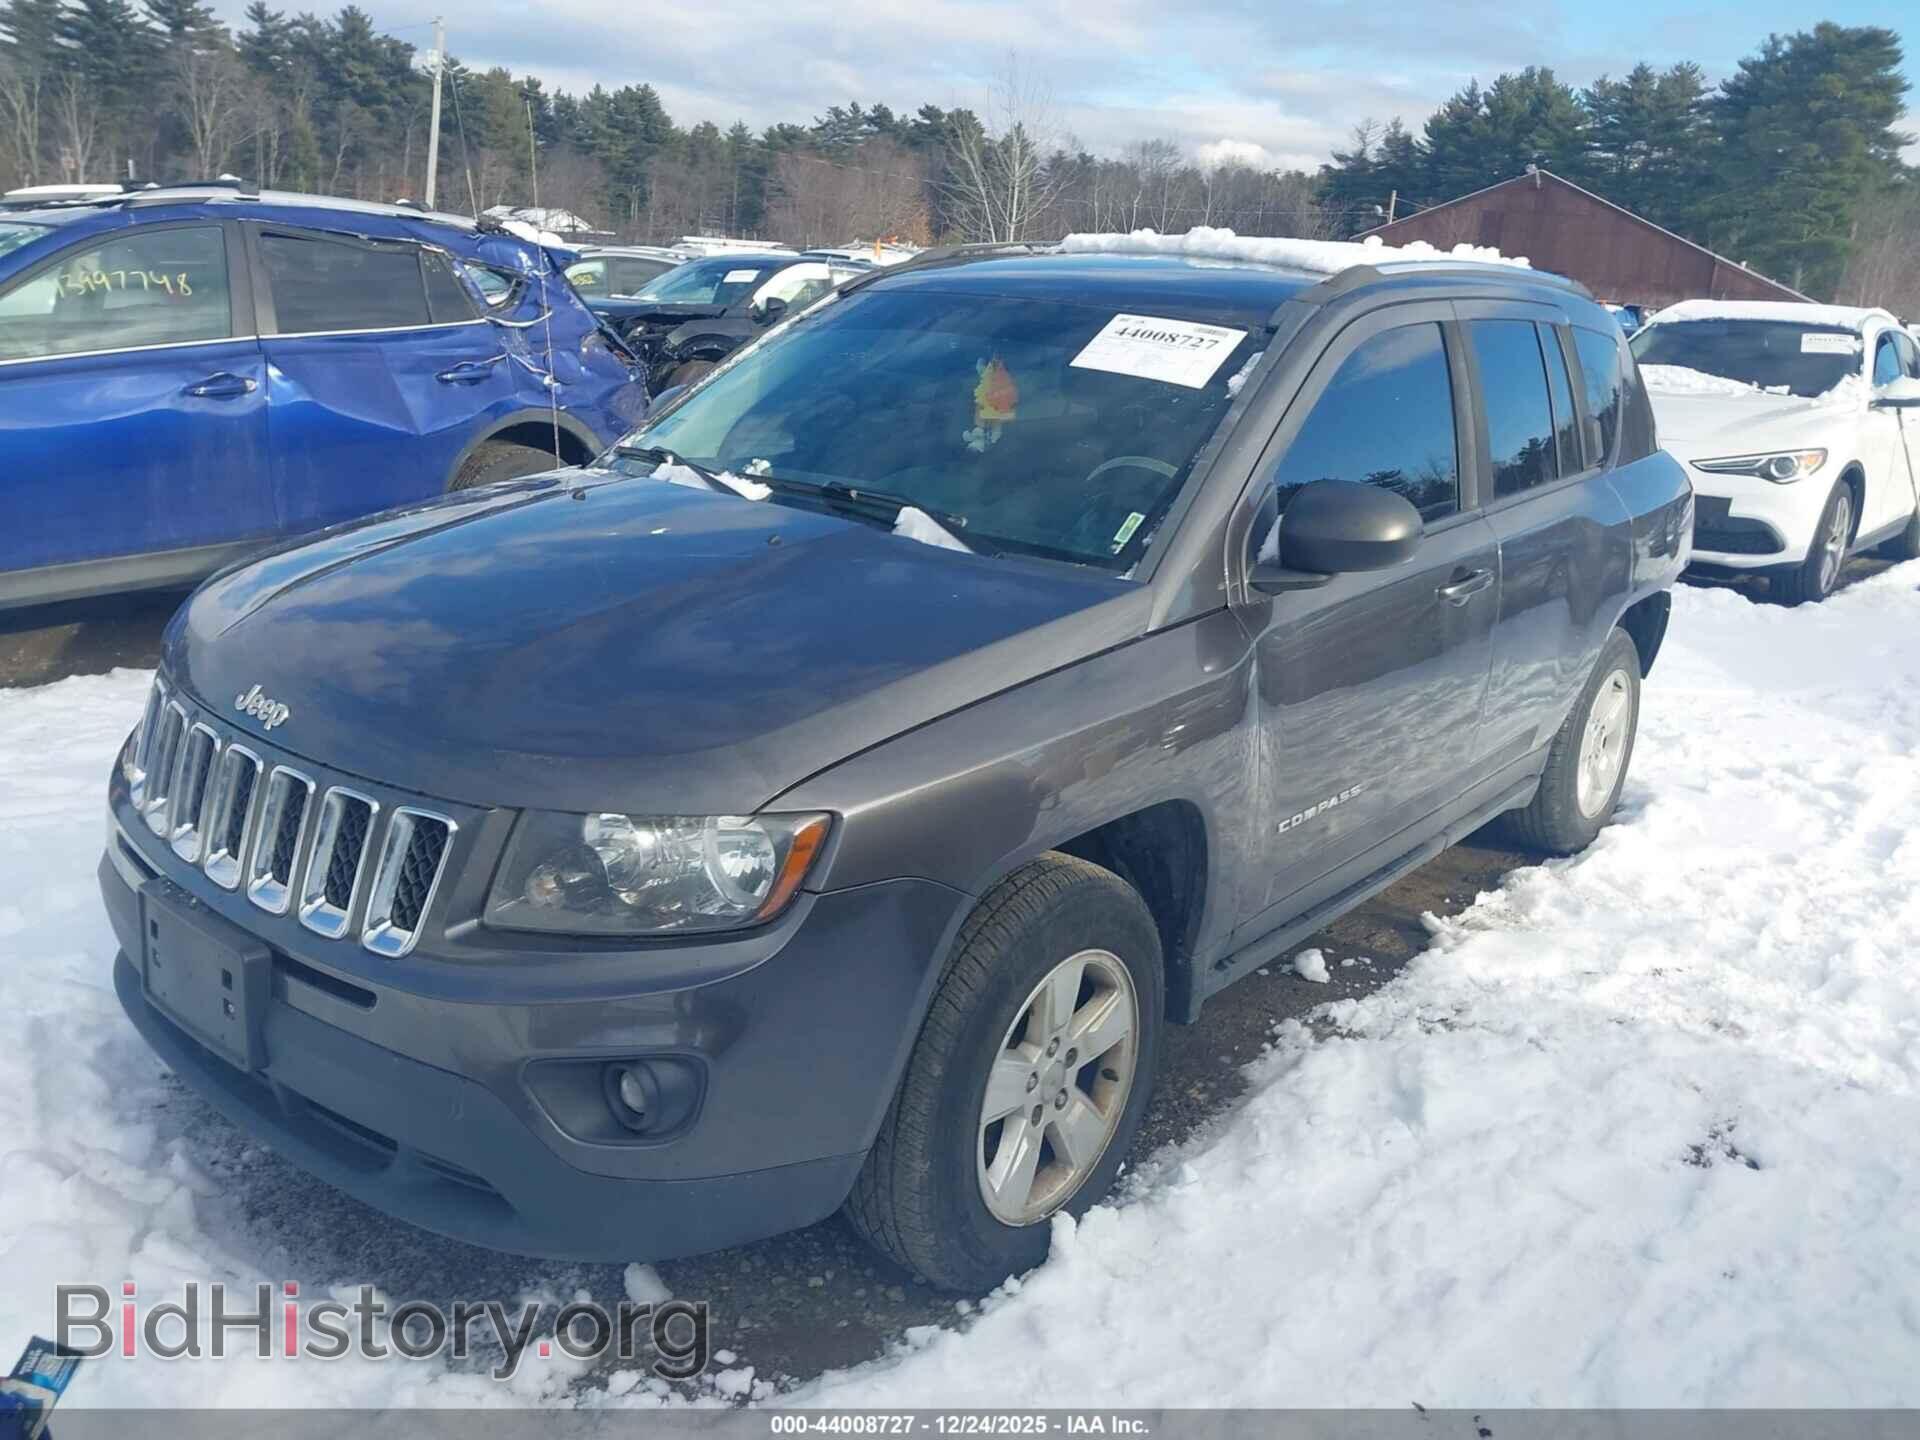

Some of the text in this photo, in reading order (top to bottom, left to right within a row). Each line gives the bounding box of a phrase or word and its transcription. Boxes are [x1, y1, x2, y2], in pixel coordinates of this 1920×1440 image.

[1114, 326, 1220, 350] 44008727
[235, 684, 289, 731] Jeep
[1278, 783, 1362, 833] COMPASS
